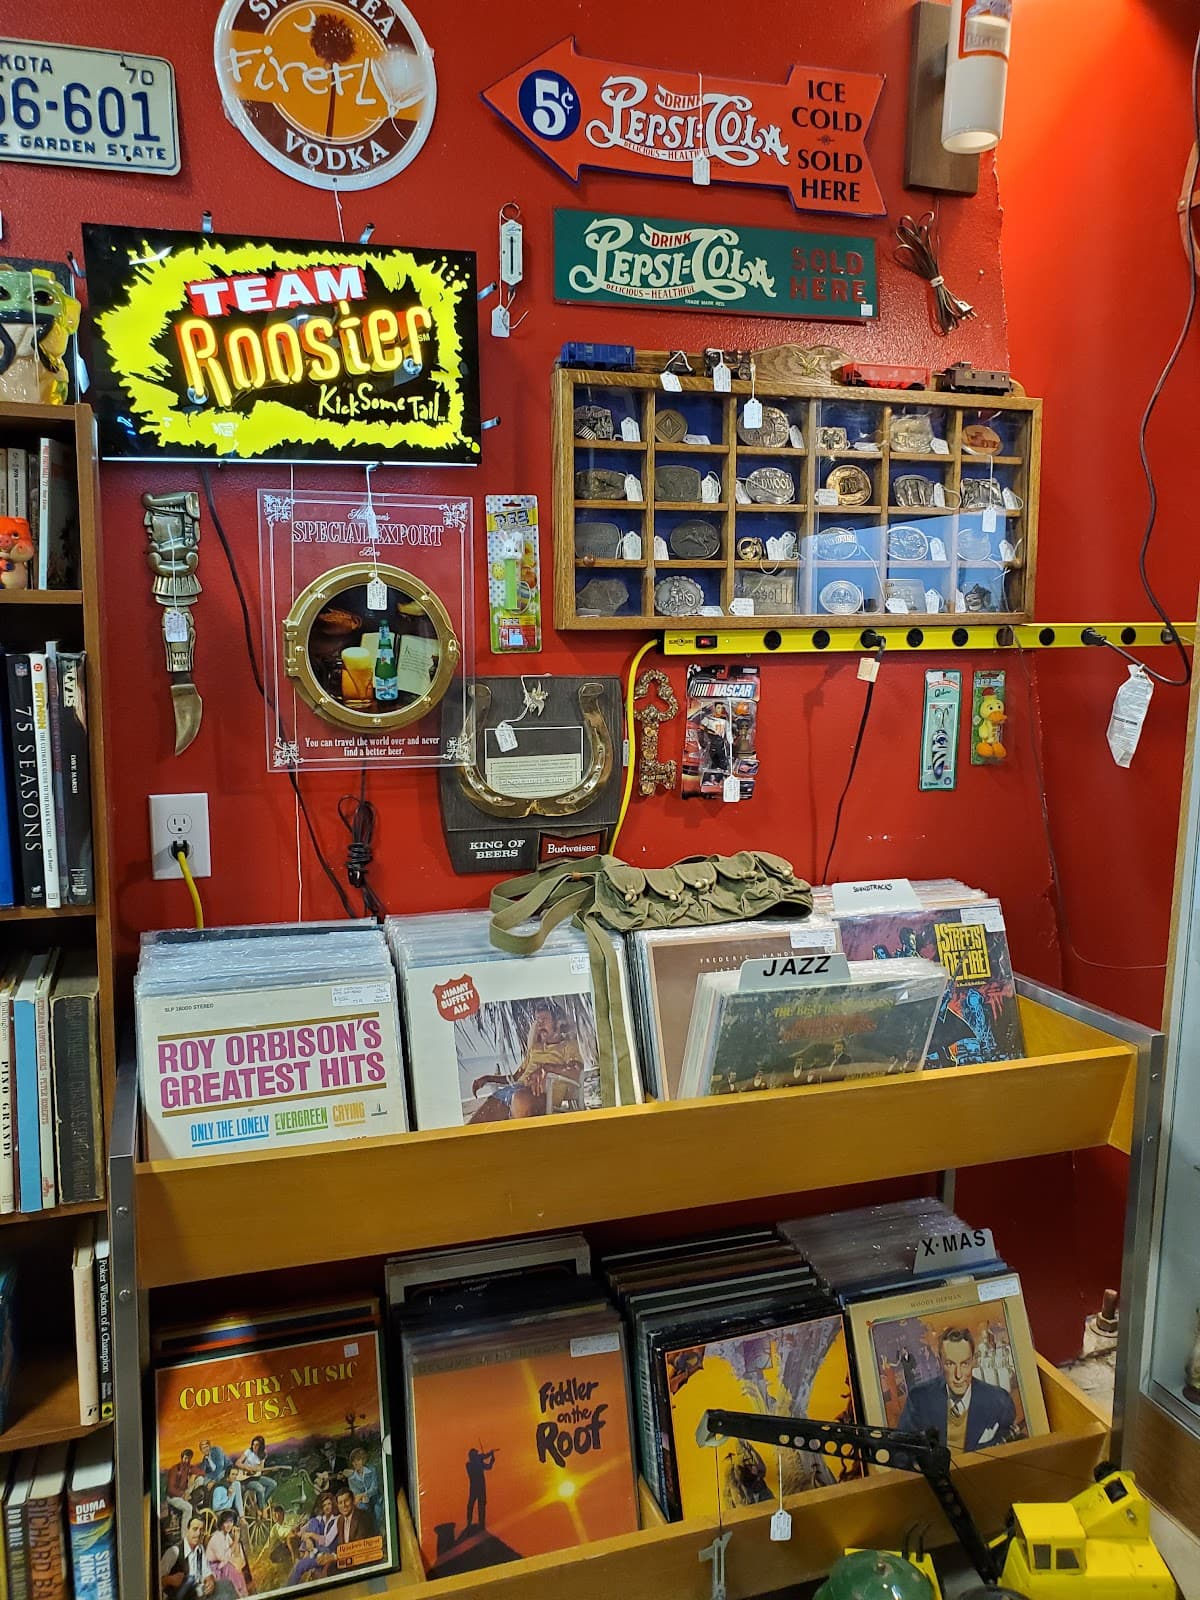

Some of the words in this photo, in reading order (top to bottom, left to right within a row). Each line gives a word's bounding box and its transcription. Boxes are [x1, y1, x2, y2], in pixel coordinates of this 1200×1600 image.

[124, 68, 154, 86] 70
[808, 79, 846, 103] ICE
[0, 77, 160, 142] 6-601
[791, 106, 863, 132] COLD
[20, 135, 96, 154] GARDEN
[107, 143, 167, 161] STATE
[285, 128, 389, 171] VODKA
[623, 141, 660, 158] DELICIOUS
[797, 148, 863, 174] SOLD
[801, 178, 860, 203] HERE
[651, 231, 692, 248] DRINK
[791, 247, 865, 276] SOLD
[190, 267, 364, 316] TEAM
[606, 283, 644, 298] DELICIOUS
[651, 285, 695, 299] HEALTHFUL
[790, 276, 868, 304] HERE
[292, 521, 370, 544] SPECIAL
[374, 523, 444, 546] EXPORT
[715, 684, 753, 698] NASCAR
[15, 706, 32, 732] 75
[35, 682, 47, 730] BATMAN
[305, 737, 318, 748] You
[320, 739, 333, 747] can
[334, 738, 355, 747] travel
[357, 737, 368, 747] the
[369, 736, 390, 746] world
[391, 738, 405, 746] over
[407, 736, 419, 745] and
[344, 747, 358, 757] find
[359, 748, 364, 756] a
[365, 747, 386, 757] better
[71, 772, 79, 794] MARSH
[18, 744, 42, 852] SEASONS
[469, 840, 503, 850] KING
[507, 839, 525, 849] OF
[476, 849, 519, 859] BEERS
[547, 843, 597, 854] Budweiser
[940, 925, 983, 951] STREETS
[763, 955, 831, 977] JAZZ
[441, 982, 470, 1000] JIMMY
[441, 990, 474, 1010] BUFFETT
[158, 1038, 216, 1074] ROY
[225, 1019, 383, 1066] ORBISON'S
[1, 1061, 10, 1095] PINO
[160, 1060, 312, 1109] GREATEST
[319, 1051, 386, 1089] HITS
[2, 1103, 12, 1160] GRANDE
[190, 1123, 214, 1142] ONLY
[215, 1120, 234, 1139] THE
[235, 1114, 270, 1137] LONELY
[275, 1106, 328, 1131] EVERGREEN
[332, 1101, 366, 1123] CRYING
[99, 1260, 109, 1283] Poker
[99, 1283, 109, 1315] Wisdom
[101, 1316, 109, 1326] of
[99, 1333, 110, 1373] Champion
[539, 1377, 599, 1413] Fiddler
[246, 1393, 299, 1425] USA
[557, 1412, 571, 1424] on
[570, 1405, 591, 1422] the
[75, 1499, 106, 1515] DUMA
[76, 1511, 96, 1525] KEY
[27, 1499, 52, 1571] RICHARD
[79, 1554, 96, 1584] KING
